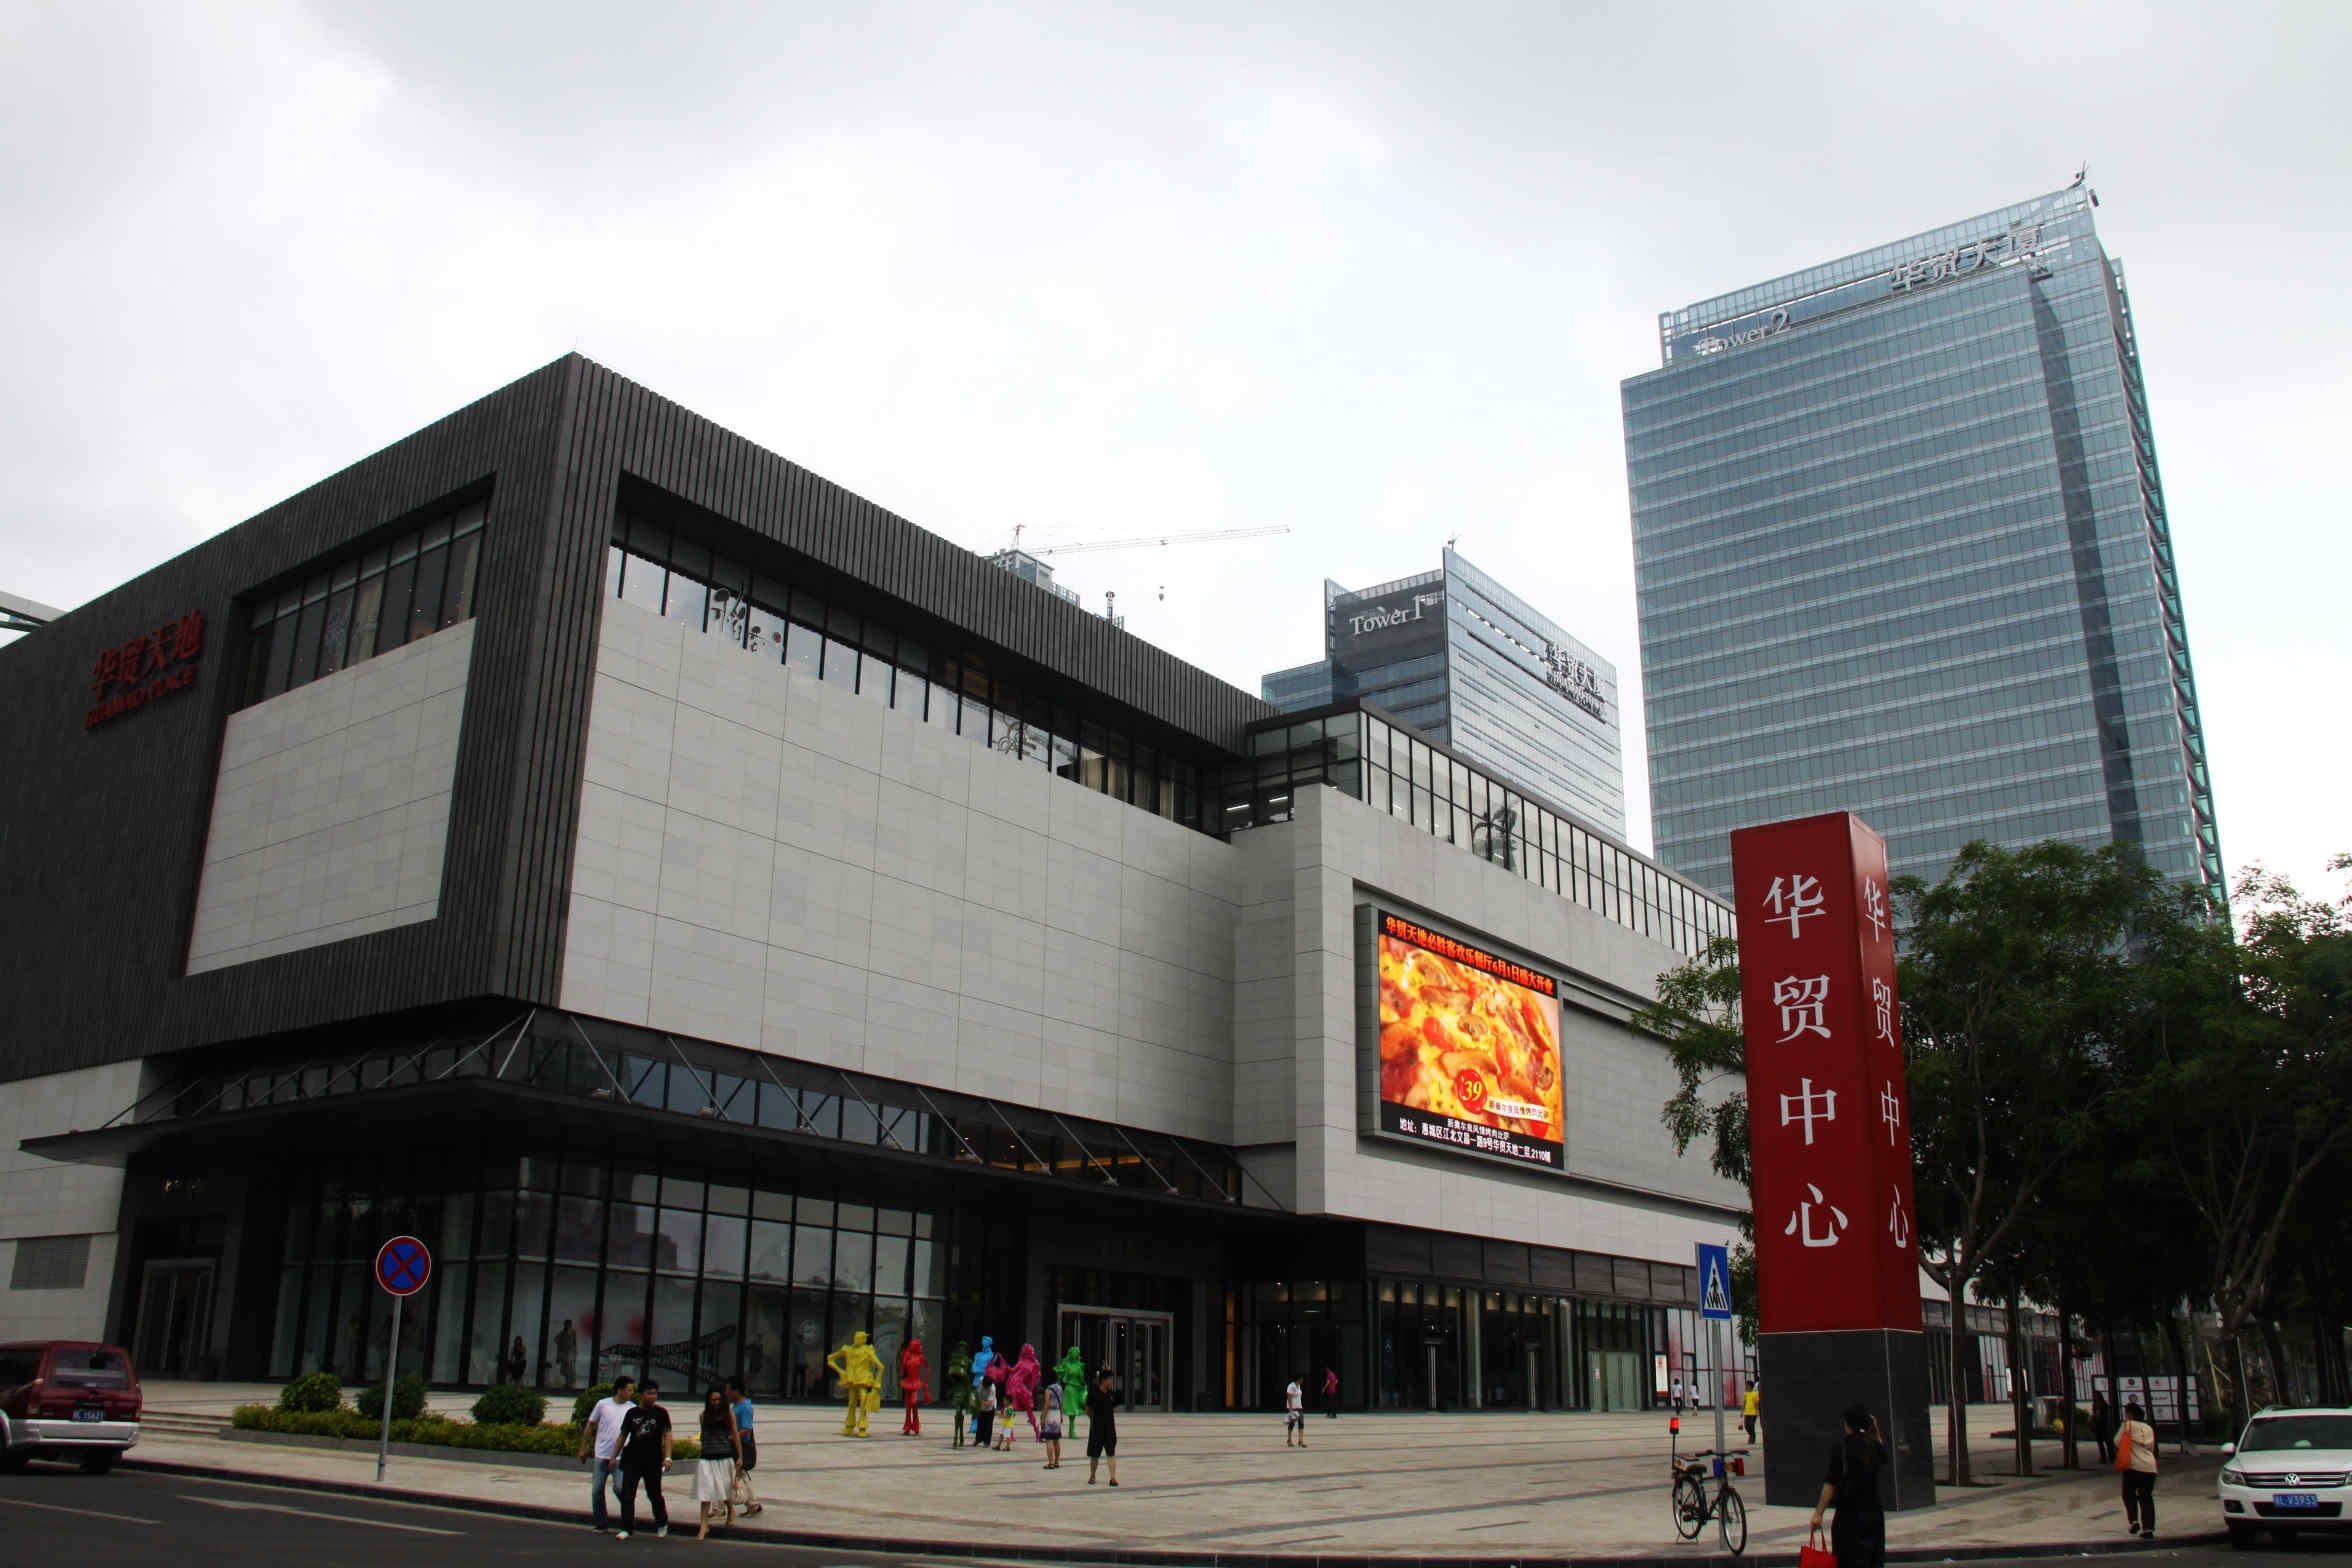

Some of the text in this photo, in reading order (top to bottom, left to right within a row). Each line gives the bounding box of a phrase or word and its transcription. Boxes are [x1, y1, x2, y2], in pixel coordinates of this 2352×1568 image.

[1695, 307, 1791, 355] Tower 2
[89, 608, 205, 702] 华贸天地
[1349, 608, 1409, 636] Tower
[1462, 1080, 1483, 1102] 39
[1762, 874, 1848, 1248] 华贸中心
[1863, 876, 1908, 1249] 华贸中心
